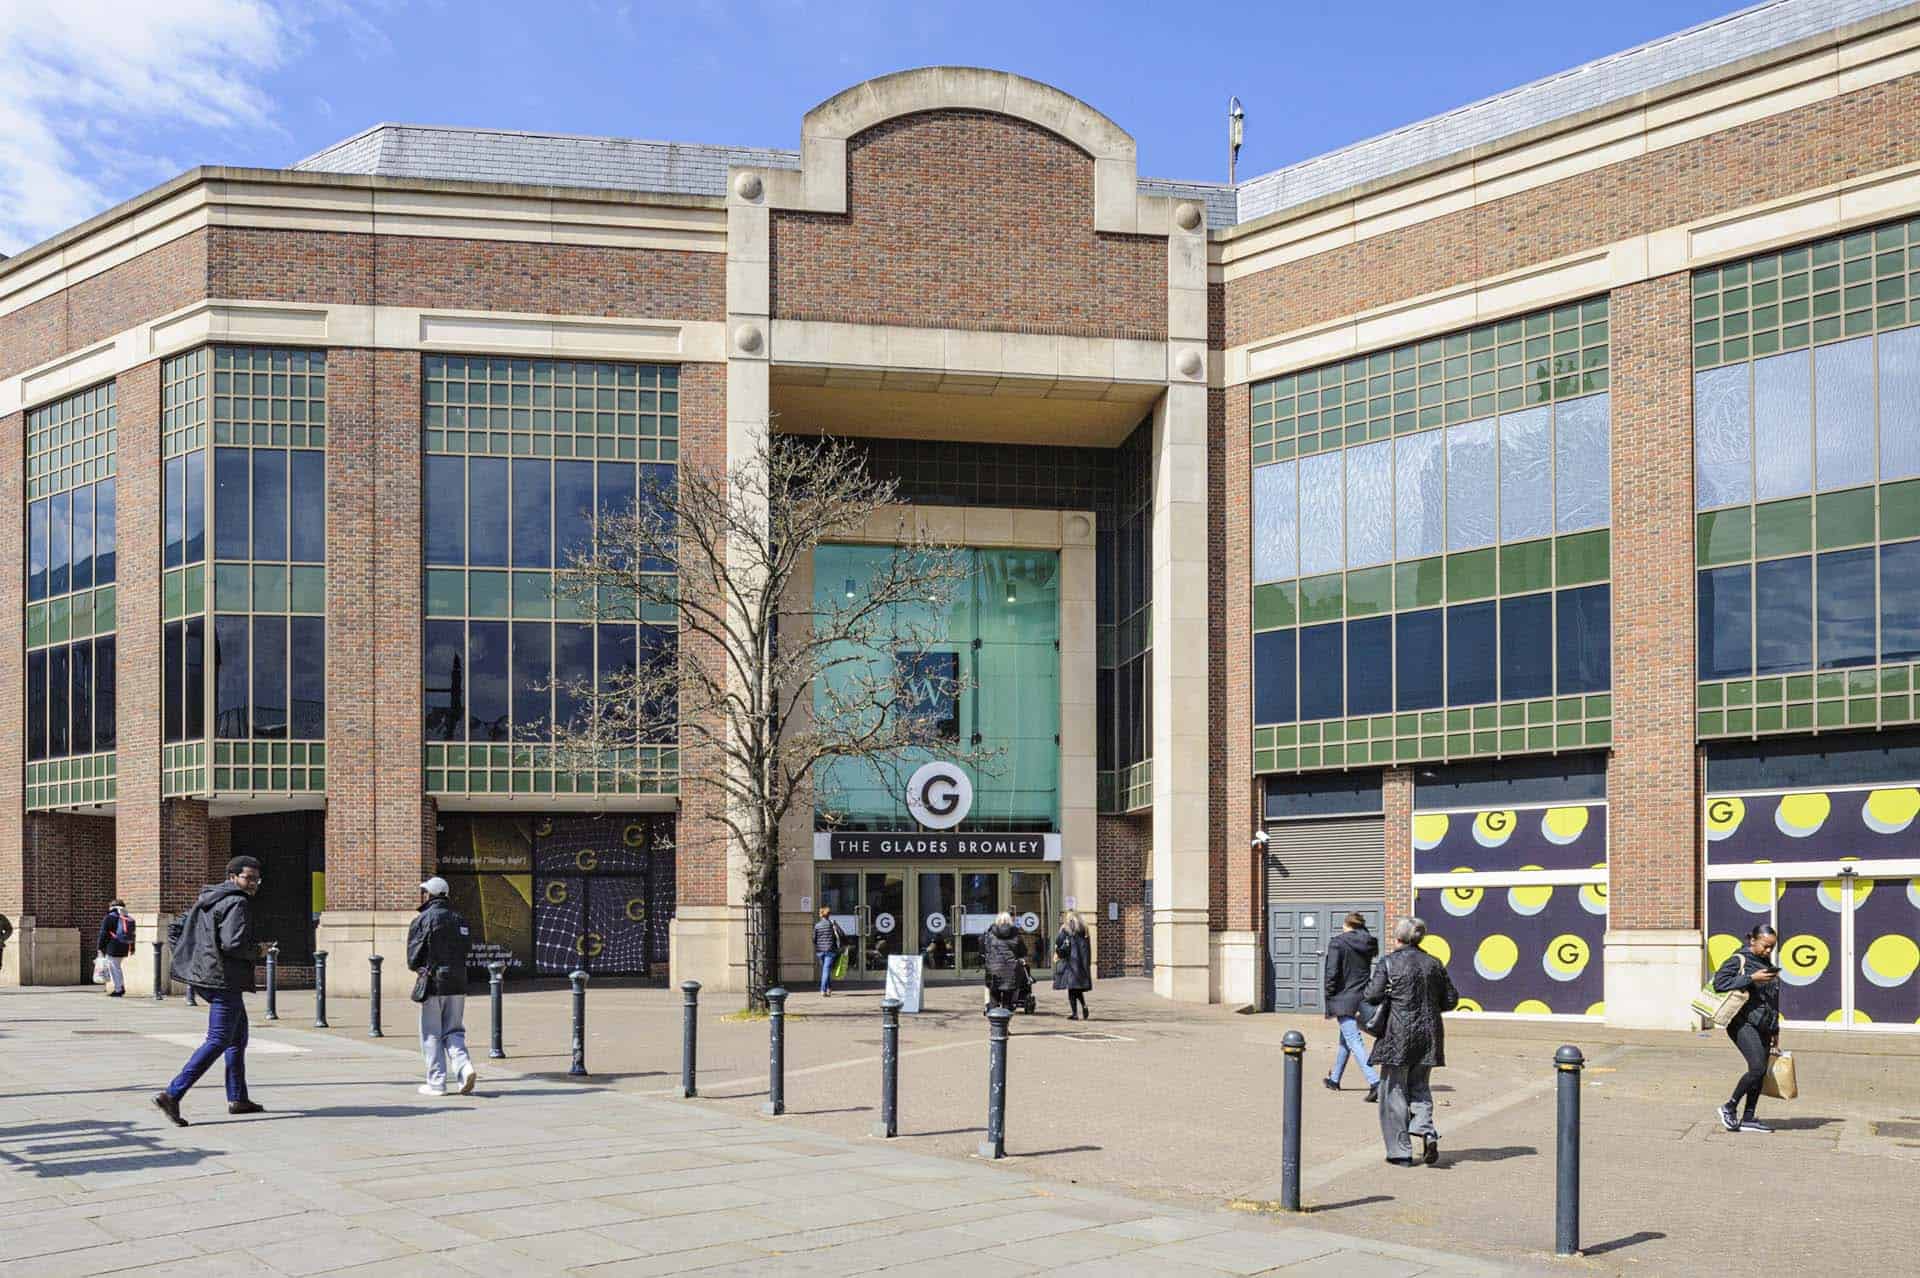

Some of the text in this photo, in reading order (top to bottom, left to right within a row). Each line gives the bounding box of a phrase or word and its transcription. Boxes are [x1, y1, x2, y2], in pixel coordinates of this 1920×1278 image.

[921, 775, 960, 815] G
[1485, 811, 1507, 831] G
[1709, 801, 1733, 823] G
[623, 825, 645, 847] G
[839, 840, 1038, 853] THE GLADES BROMLEY
[576, 849, 598, 871] G
[546, 881, 567, 904] G
[626, 898, 645, 921] G
[880, 917, 891, 928] G
[931, 917, 942, 928] G
[1024, 916, 1036, 928] G
[1557, 943, 1580, 964] G
[1791, 944, 1817, 967] G
